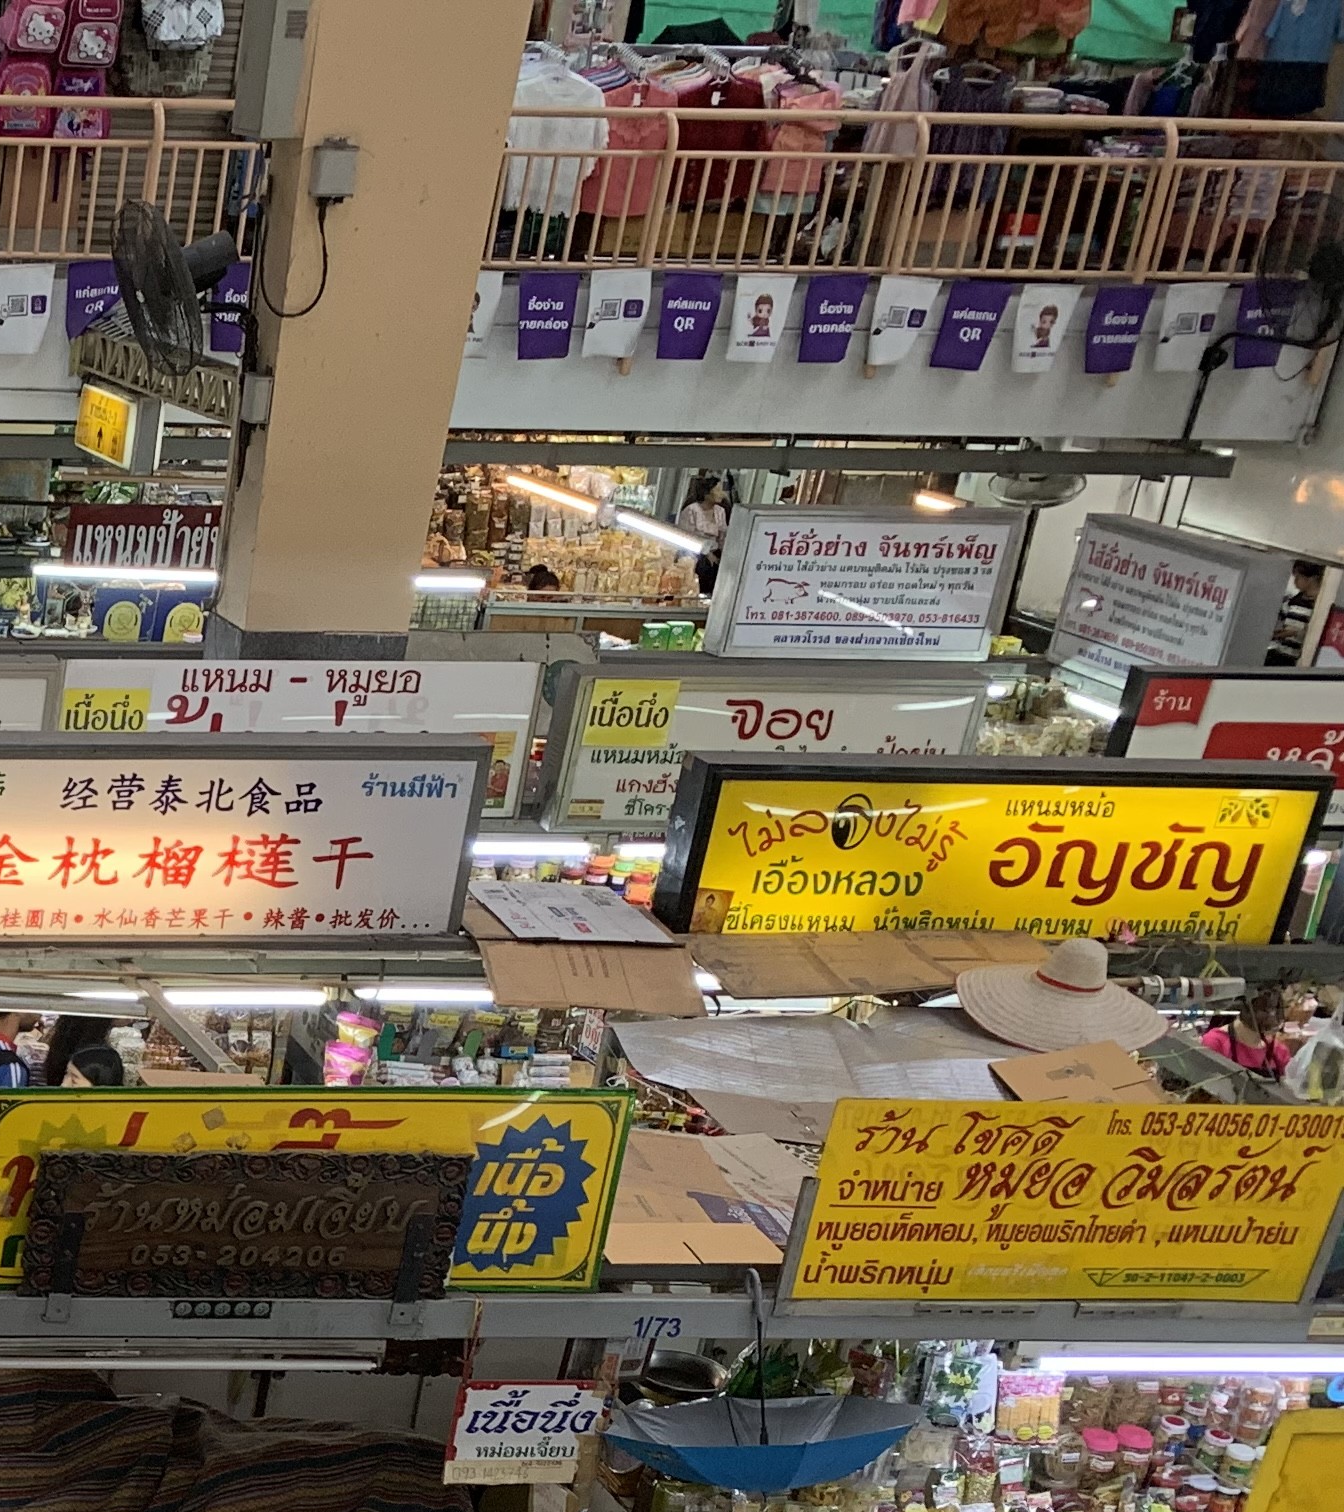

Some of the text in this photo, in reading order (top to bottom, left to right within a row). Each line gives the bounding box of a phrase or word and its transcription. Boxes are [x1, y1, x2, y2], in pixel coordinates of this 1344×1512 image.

[672, 315, 696, 333] QR
[958, 326, 983, 342] QR
[764, 528, 999, 565] ไส้อั่วย่าง จันทร์เพ็ญ
[180, 667, 423, 709] แหนม หมูยอ
[1152, 690, 1193, 712] ร้าน
[64, 691, 146, 732] เนื้อนึ่ง
[588, 690, 671, 730] เนื้อนึ่ง
[725, 699, 836, 742] จอย
[59, 776, 326, 817] 经营泰北食品
[360, 769, 460, 801] ร้านมีฟ้า
[1005, 791, 1117, 820] แหนมหม้อ
[988, 819, 1266, 909] อัญชัญ
[855, 1107, 1086, 1158] ร้าน โชคดี
[1107, 1109, 1133, 1137] โทร.
[472, 1137, 567, 1198] เนื้อ
[837, 1143, 1329, 1219] จำหน่าย หมูยอ วิมลรัตน์
[815, 1214, 979, 1251] หมูยอเห็ดหอม,
[802, 1253, 955, 1299] น้ำพริกหนุ่ม
[632, 1315, 683, 1339] 1/73
[464, 1389, 598, 1435] เนื้อนึ่ง
